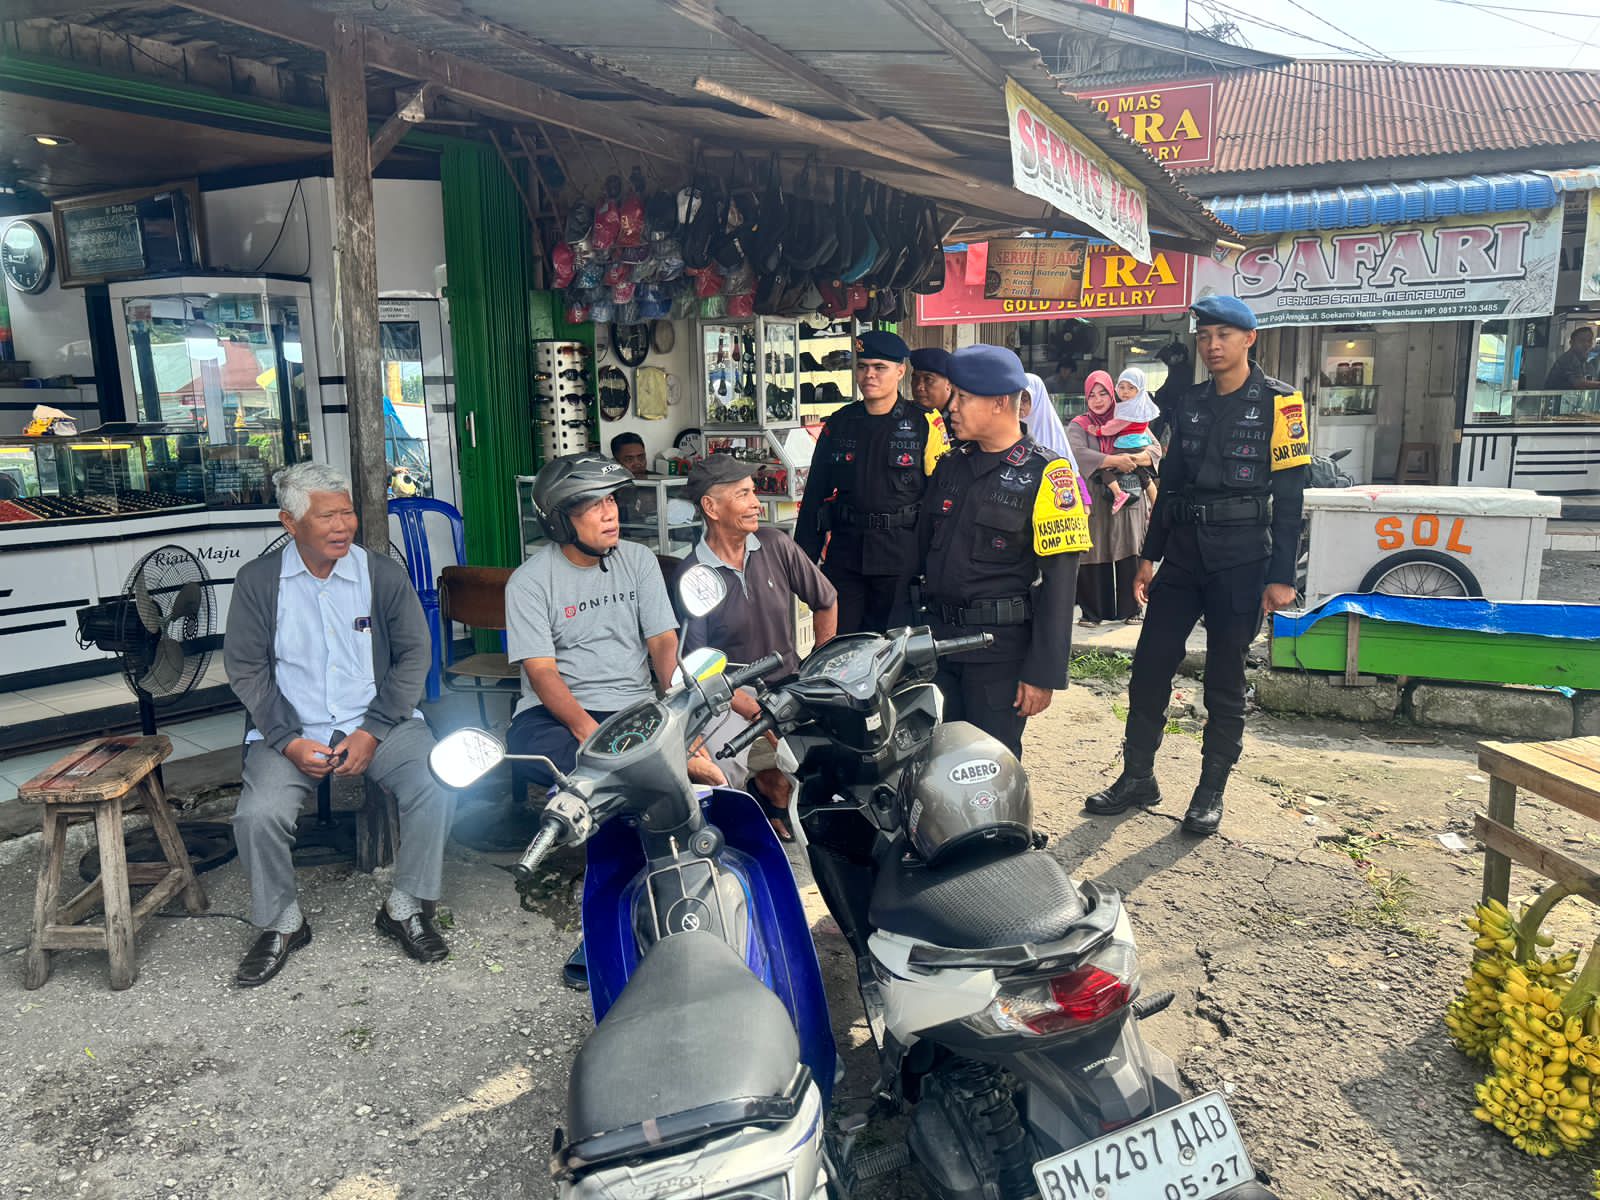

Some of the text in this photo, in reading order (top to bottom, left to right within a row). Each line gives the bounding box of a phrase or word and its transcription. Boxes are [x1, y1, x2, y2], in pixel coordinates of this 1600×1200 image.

[1119, 94, 1161, 113] MAS
[1016, 107, 1105, 218] SERVIS
[995, 250, 1079, 269] SERVICE JAM
[1234, 222, 1530, 298] SAFARI
[1331, 293, 1381, 304] SAMBIL
[1384, 288, 1466, 301] MENABUNG
[1003, 299, 1051, 312] GOLD
[1321, 311, 1356, 319] Soekarno
[1357, 309, 1376, 318] Hatta
[1382, 308, 1423, 317] Pekanbaru
[1438, 306, 1457, 314] 0813
[1459, 305, 1477, 313] 7120
[1479, 304, 1498, 312] 3485
[890, 441, 920, 449] POLRI
[1273, 445, 1290, 462] SAR
[1041, 537, 1061, 550] OMP
[1065, 534, 1077, 546] LK
[1375, 514, 1472, 555] SOL
[155, 546, 241, 567] Riau Maju
[952, 763, 997, 781] CABERG
[1082, 1056, 1119, 1073] HONDA
[1042, 1104, 1228, 1200] BM 4267 AAB
